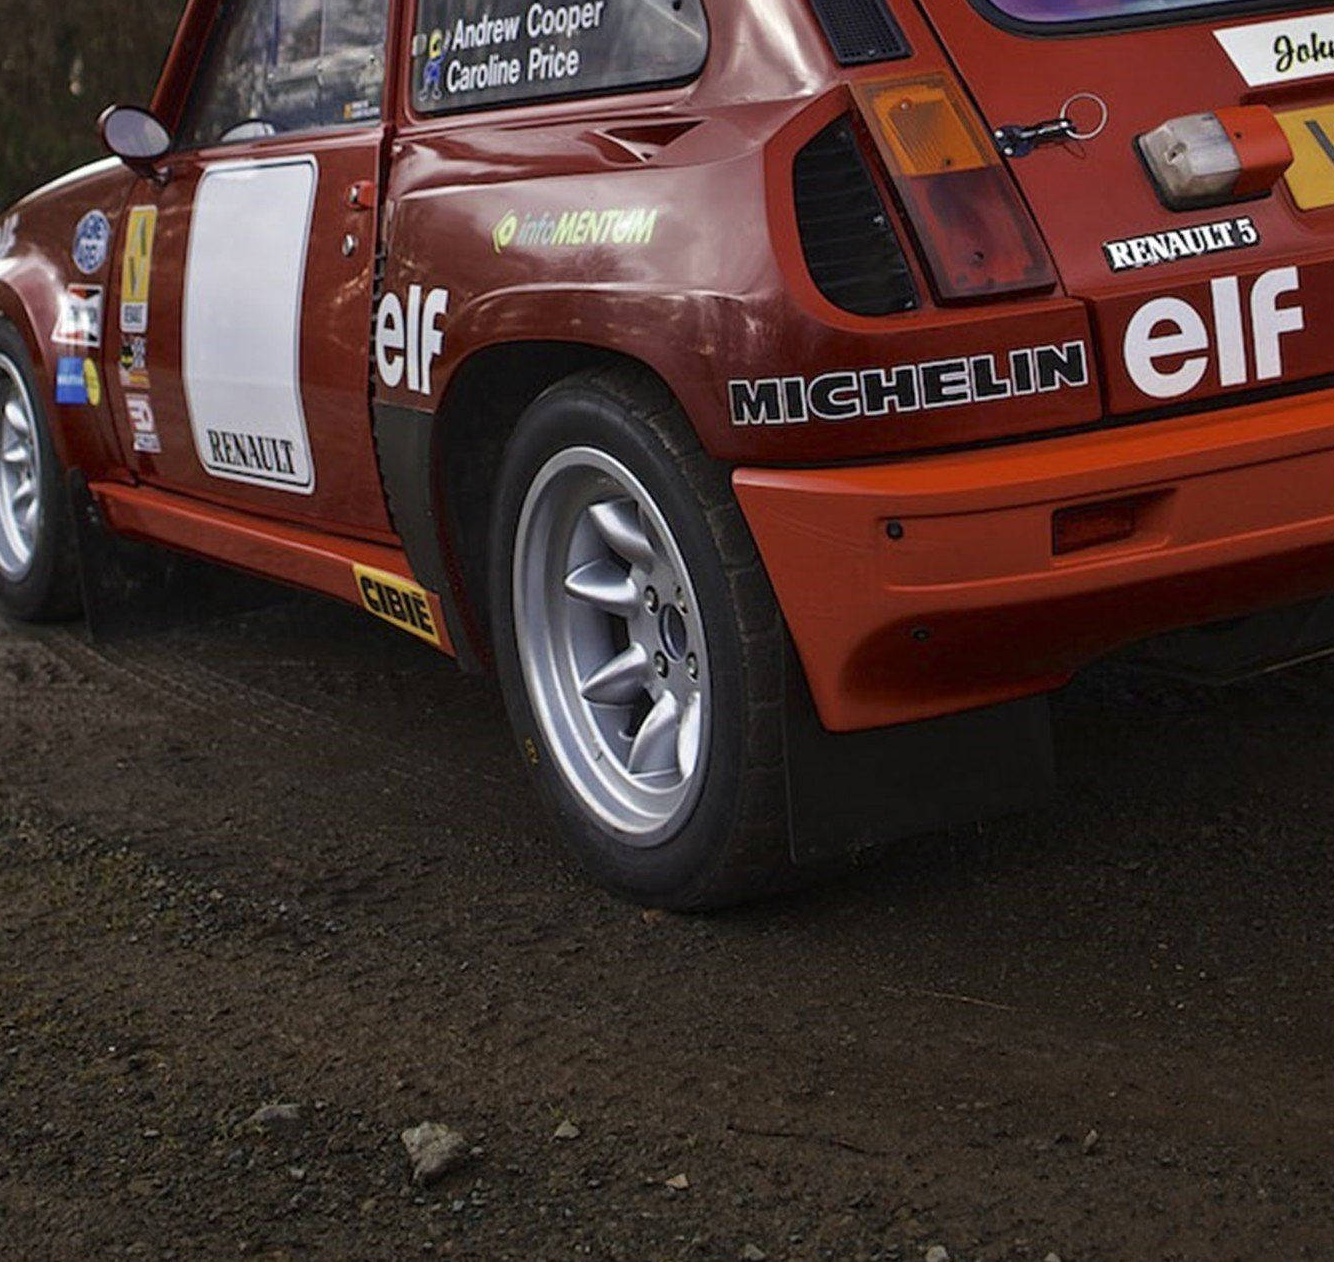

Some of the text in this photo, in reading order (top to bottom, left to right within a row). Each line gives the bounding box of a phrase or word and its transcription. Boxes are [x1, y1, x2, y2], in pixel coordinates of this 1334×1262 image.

[451, 0, 604, 51] Andrew Cooper
[447, 45, 579, 93] Caroline Price
[518, 208, 658, 246] infoMENTUM
[1107, 218, 1258, 270] RENAULT 5
[375, 284, 448, 395] elf
[1123, 266, 1304, 398] elf
[728, 340, 1088, 425] MICHELIN
[207, 427, 296, 475] RENAULT
